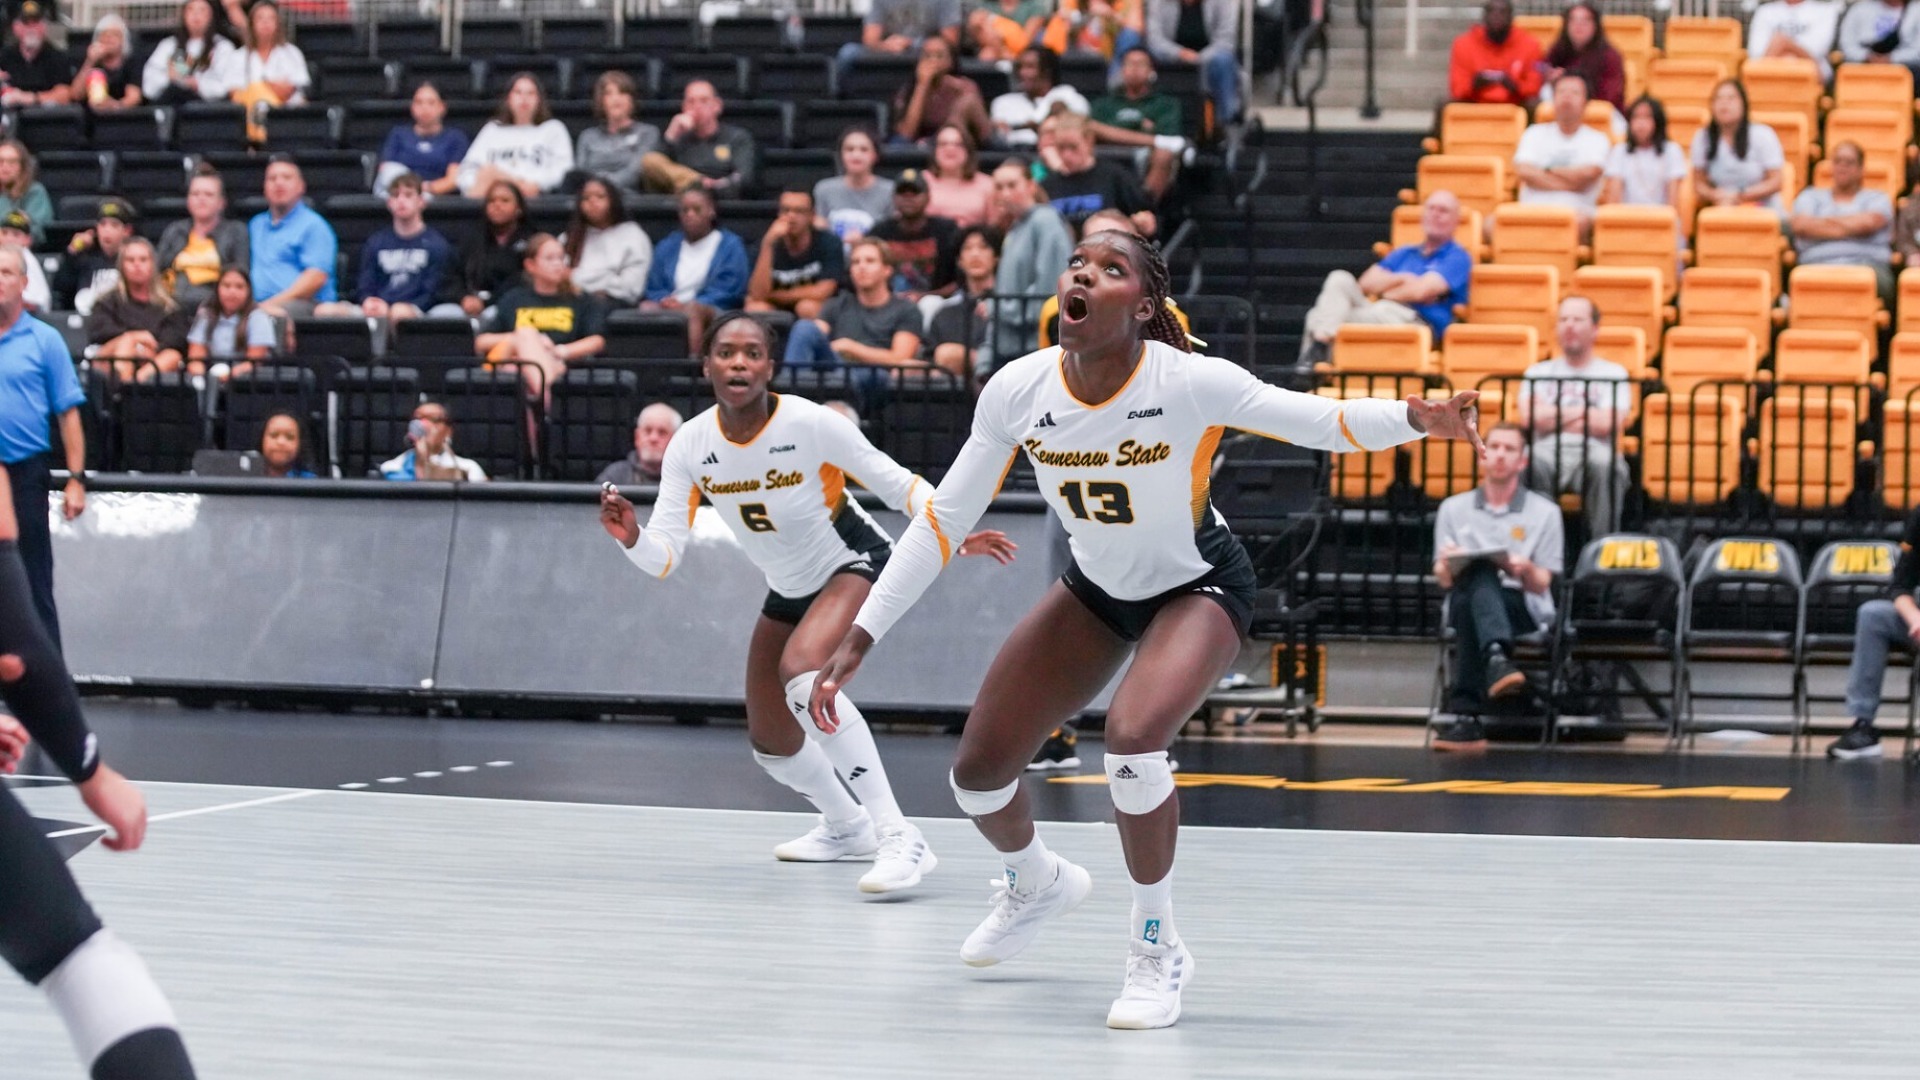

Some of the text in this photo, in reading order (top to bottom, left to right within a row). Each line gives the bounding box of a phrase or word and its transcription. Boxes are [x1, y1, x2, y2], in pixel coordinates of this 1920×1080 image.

[1025, 438, 1171, 467] Kennesaw State
[701, 468, 804, 494] Kennesaw State
[1058, 480, 1134, 524] 13
[738, 502, 777, 533] 6
[1599, 538, 1661, 570] OWLS
[1716, 541, 1780, 572] OWLS
[1830, 545, 1893, 575] OWLS
[1114, 772, 1139, 780] adidas
